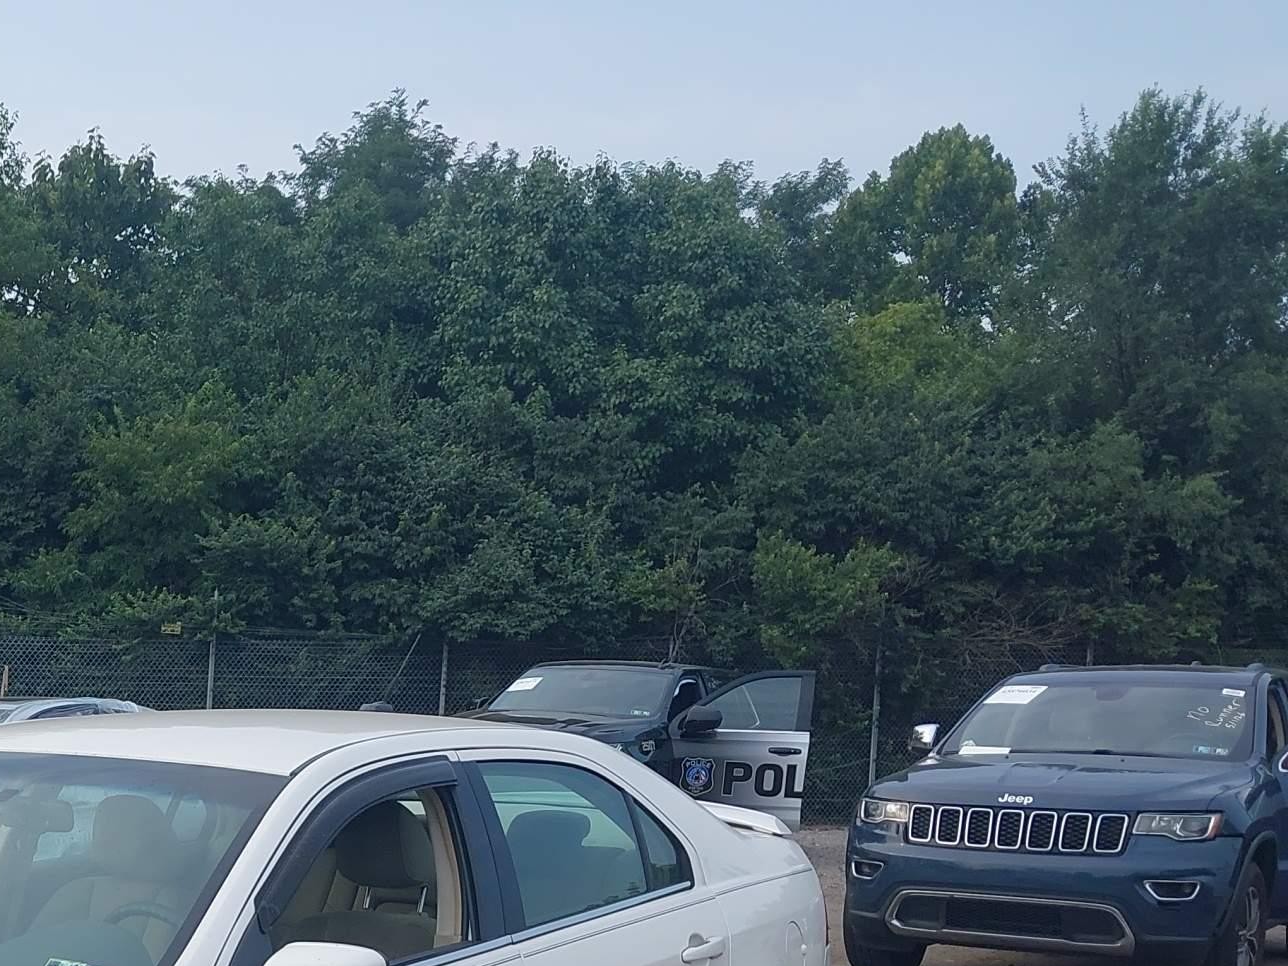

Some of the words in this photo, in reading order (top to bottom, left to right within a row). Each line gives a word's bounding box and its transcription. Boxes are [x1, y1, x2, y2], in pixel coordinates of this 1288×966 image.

[685, 760, 712, 769] POLICE
[722, 761, 805, 798] POL
[998, 793, 1033, 806] Jeep
